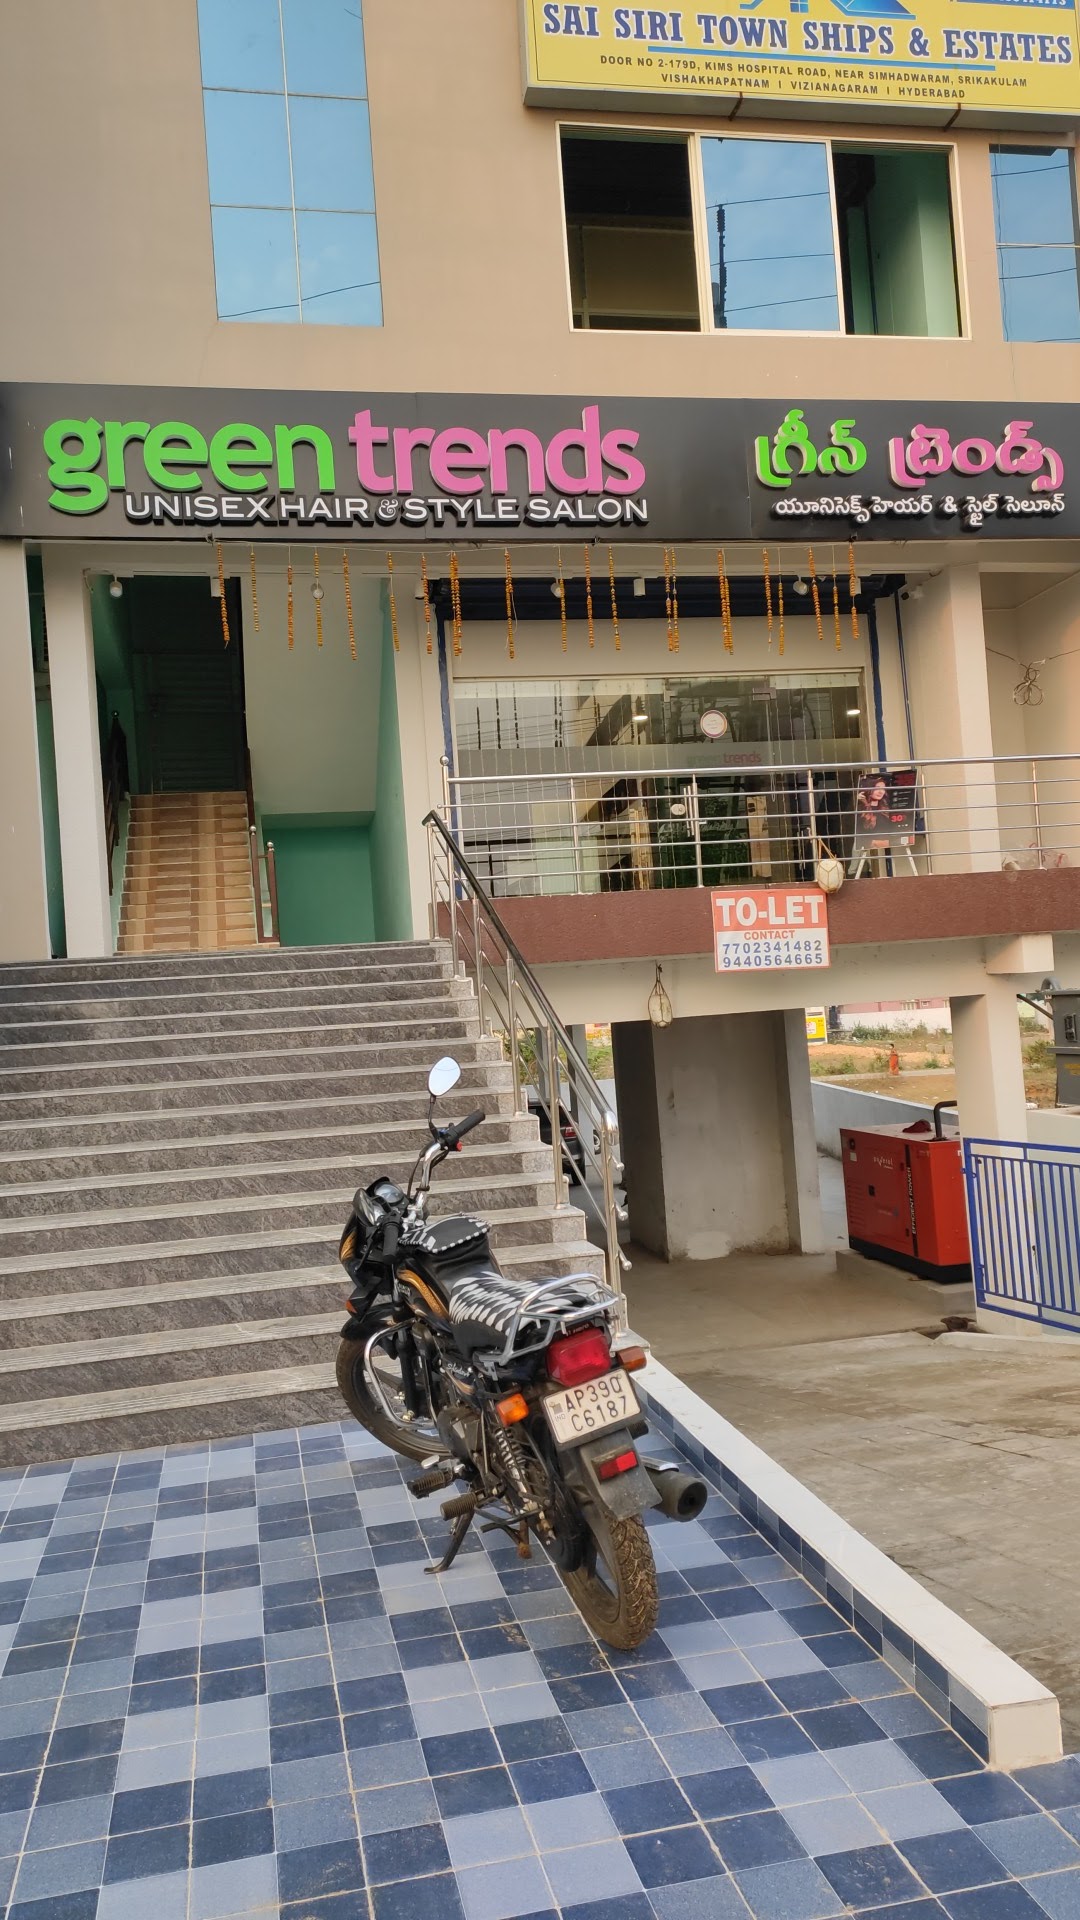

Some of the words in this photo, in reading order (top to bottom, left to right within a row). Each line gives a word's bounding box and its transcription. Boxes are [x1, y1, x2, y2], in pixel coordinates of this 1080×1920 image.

[544, 4, 599, 36] SAI
[614, 9, 683, 42] SIRI
[697, 14, 788, 48] TOWN
[803, 21, 893, 54] SHIPS
[909, 27, 930, 56] &
[943, 29, 1072, 64] ESTATES
[600, 55, 632, 66] DOOR
[637, 58, 653, 67] NO
[658, 59, 700, 71] 2-179D,
[705, 61, 733, 72] KIMS
[738, 63, 793, 75] HOSPITAL
[797, 66, 831, 79] ROAD,
[835, 69, 864, 79] NEAR
[868, 71, 954, 85] SIMHADWARAM,
[958, 75, 1027, 87] SRIKAKULAM
[661, 73, 770, 89] VISHAKHAPATNAM
[791, 81, 878, 94] VIZIANAGARAM
[898, 87, 966, 98] HYDERABAD
[43, 416, 336, 514] green
[347, 404, 648, 496] trends
[754, 408, 868, 488] గ్రీన్
[888, 420, 1065, 493] ట్రెండ్స్
[125, 494, 271, 520] UNISEX
[279, 496, 369, 521] HAIR
[378, 498, 399, 519] &
[404, 498, 520, 520] STYLE
[528, 498, 649, 520] SALON
[943, 495, 958, 514] &
[1006, 493, 1066, 514] సెలూన్
[715, 895, 824, 927] TO-LET
[722, 940, 823, 955] 7702341482
[743, 930, 796, 941] CONTACT
[723, 953, 823, 968] 9440564665
[571, 1395, 627, 1432] C6187
